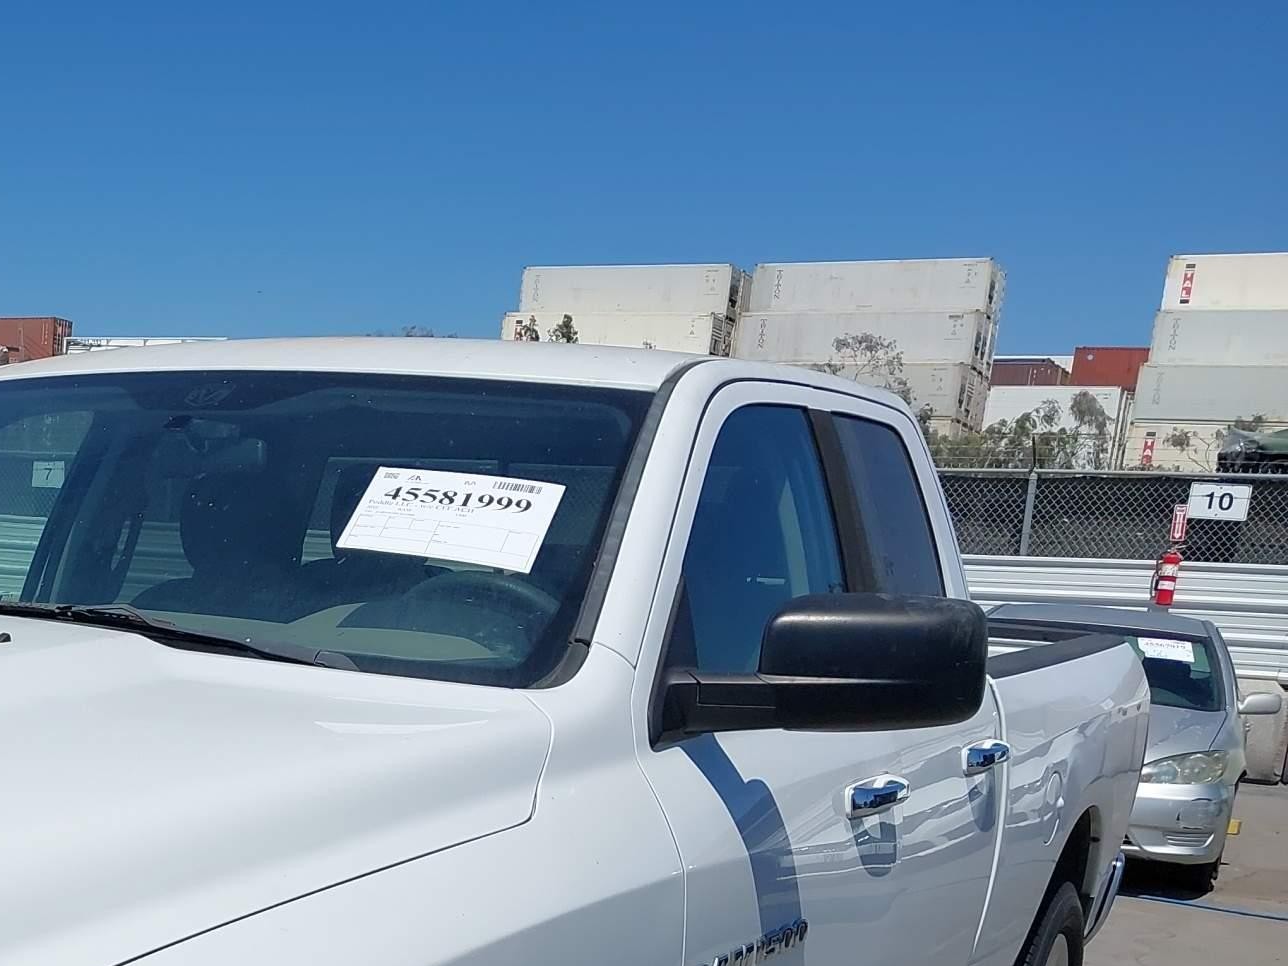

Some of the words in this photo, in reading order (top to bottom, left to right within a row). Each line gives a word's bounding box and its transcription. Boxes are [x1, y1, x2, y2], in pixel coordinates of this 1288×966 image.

[1181, 271, 1195, 298] TAL
[43, 467, 53, 481] 7
[384, 486, 532, 514] 45581999
[1205, 491, 1234, 511] 10
